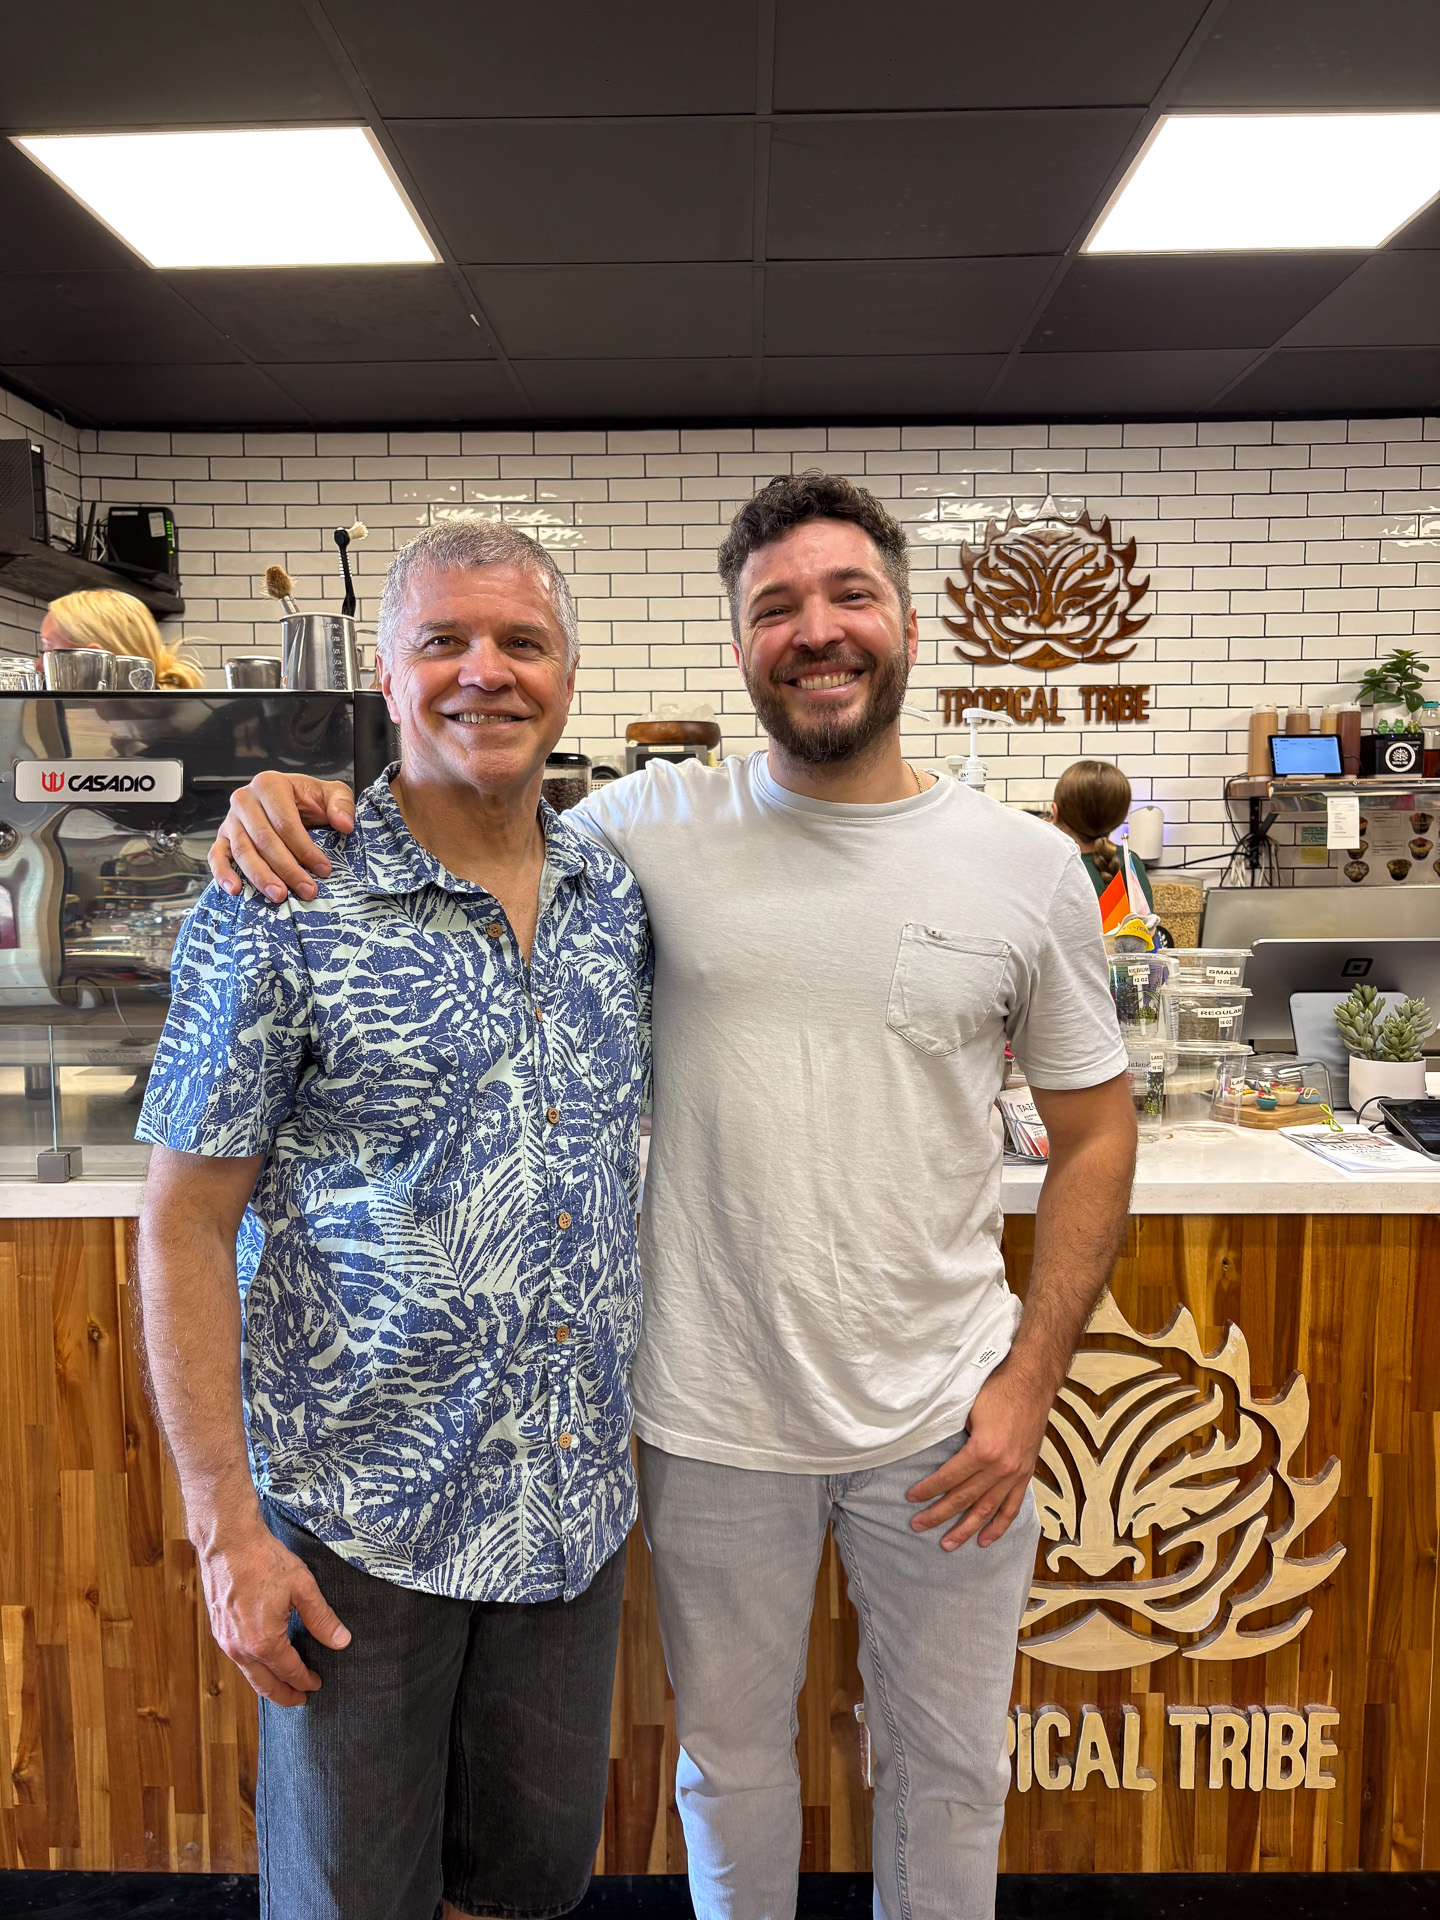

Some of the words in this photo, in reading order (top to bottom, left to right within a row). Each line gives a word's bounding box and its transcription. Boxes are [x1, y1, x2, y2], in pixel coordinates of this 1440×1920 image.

[938, 686, 1066, 725] TROPICAL
[1079, 685, 1150, 722] TRIBE
[68, 775, 155, 792] CASADIO
[1200, 1008, 1242, 1016] REGULAR
[1167, 1704, 1340, 1793] TRIBE
